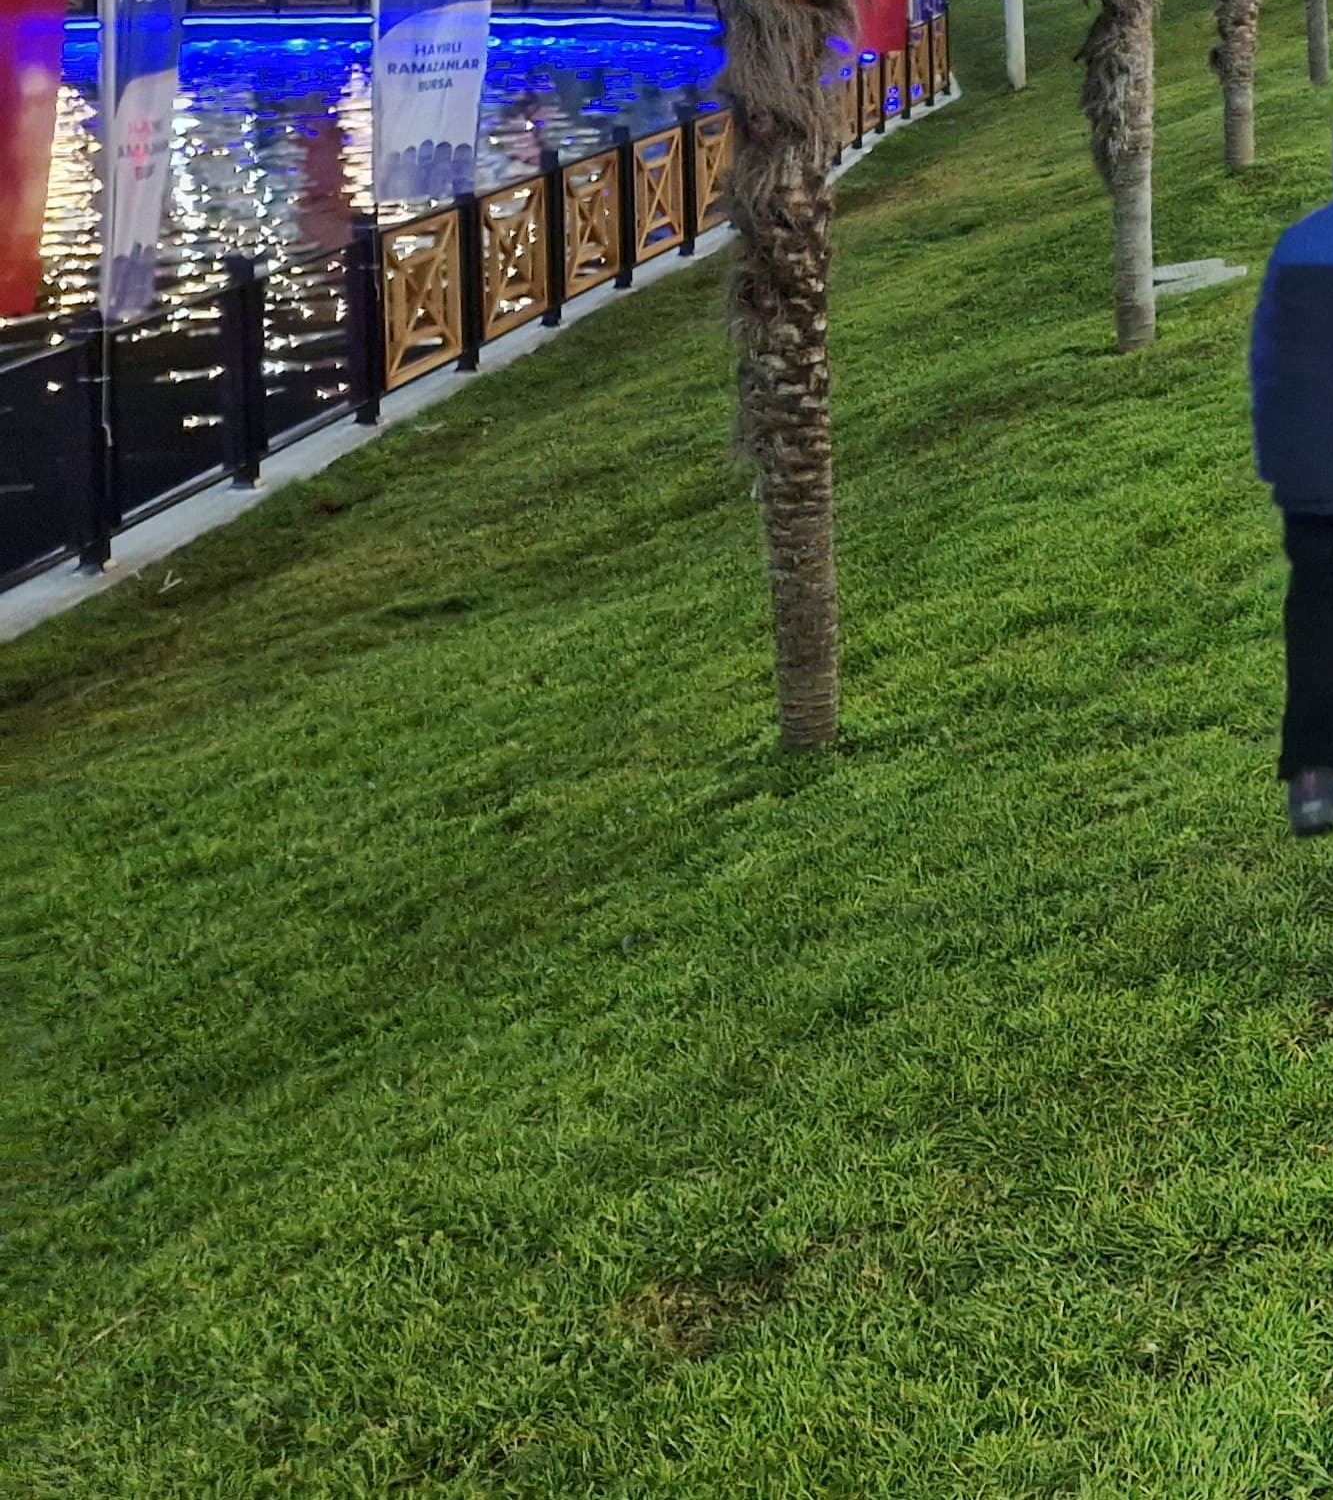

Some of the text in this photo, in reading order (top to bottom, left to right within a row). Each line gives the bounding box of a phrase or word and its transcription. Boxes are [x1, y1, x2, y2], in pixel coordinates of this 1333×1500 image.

[415, 41, 461, 56] HAYIRLI
[387, 58, 480, 75] RAMAZANLAR
[418, 78, 454, 93] BURSA
